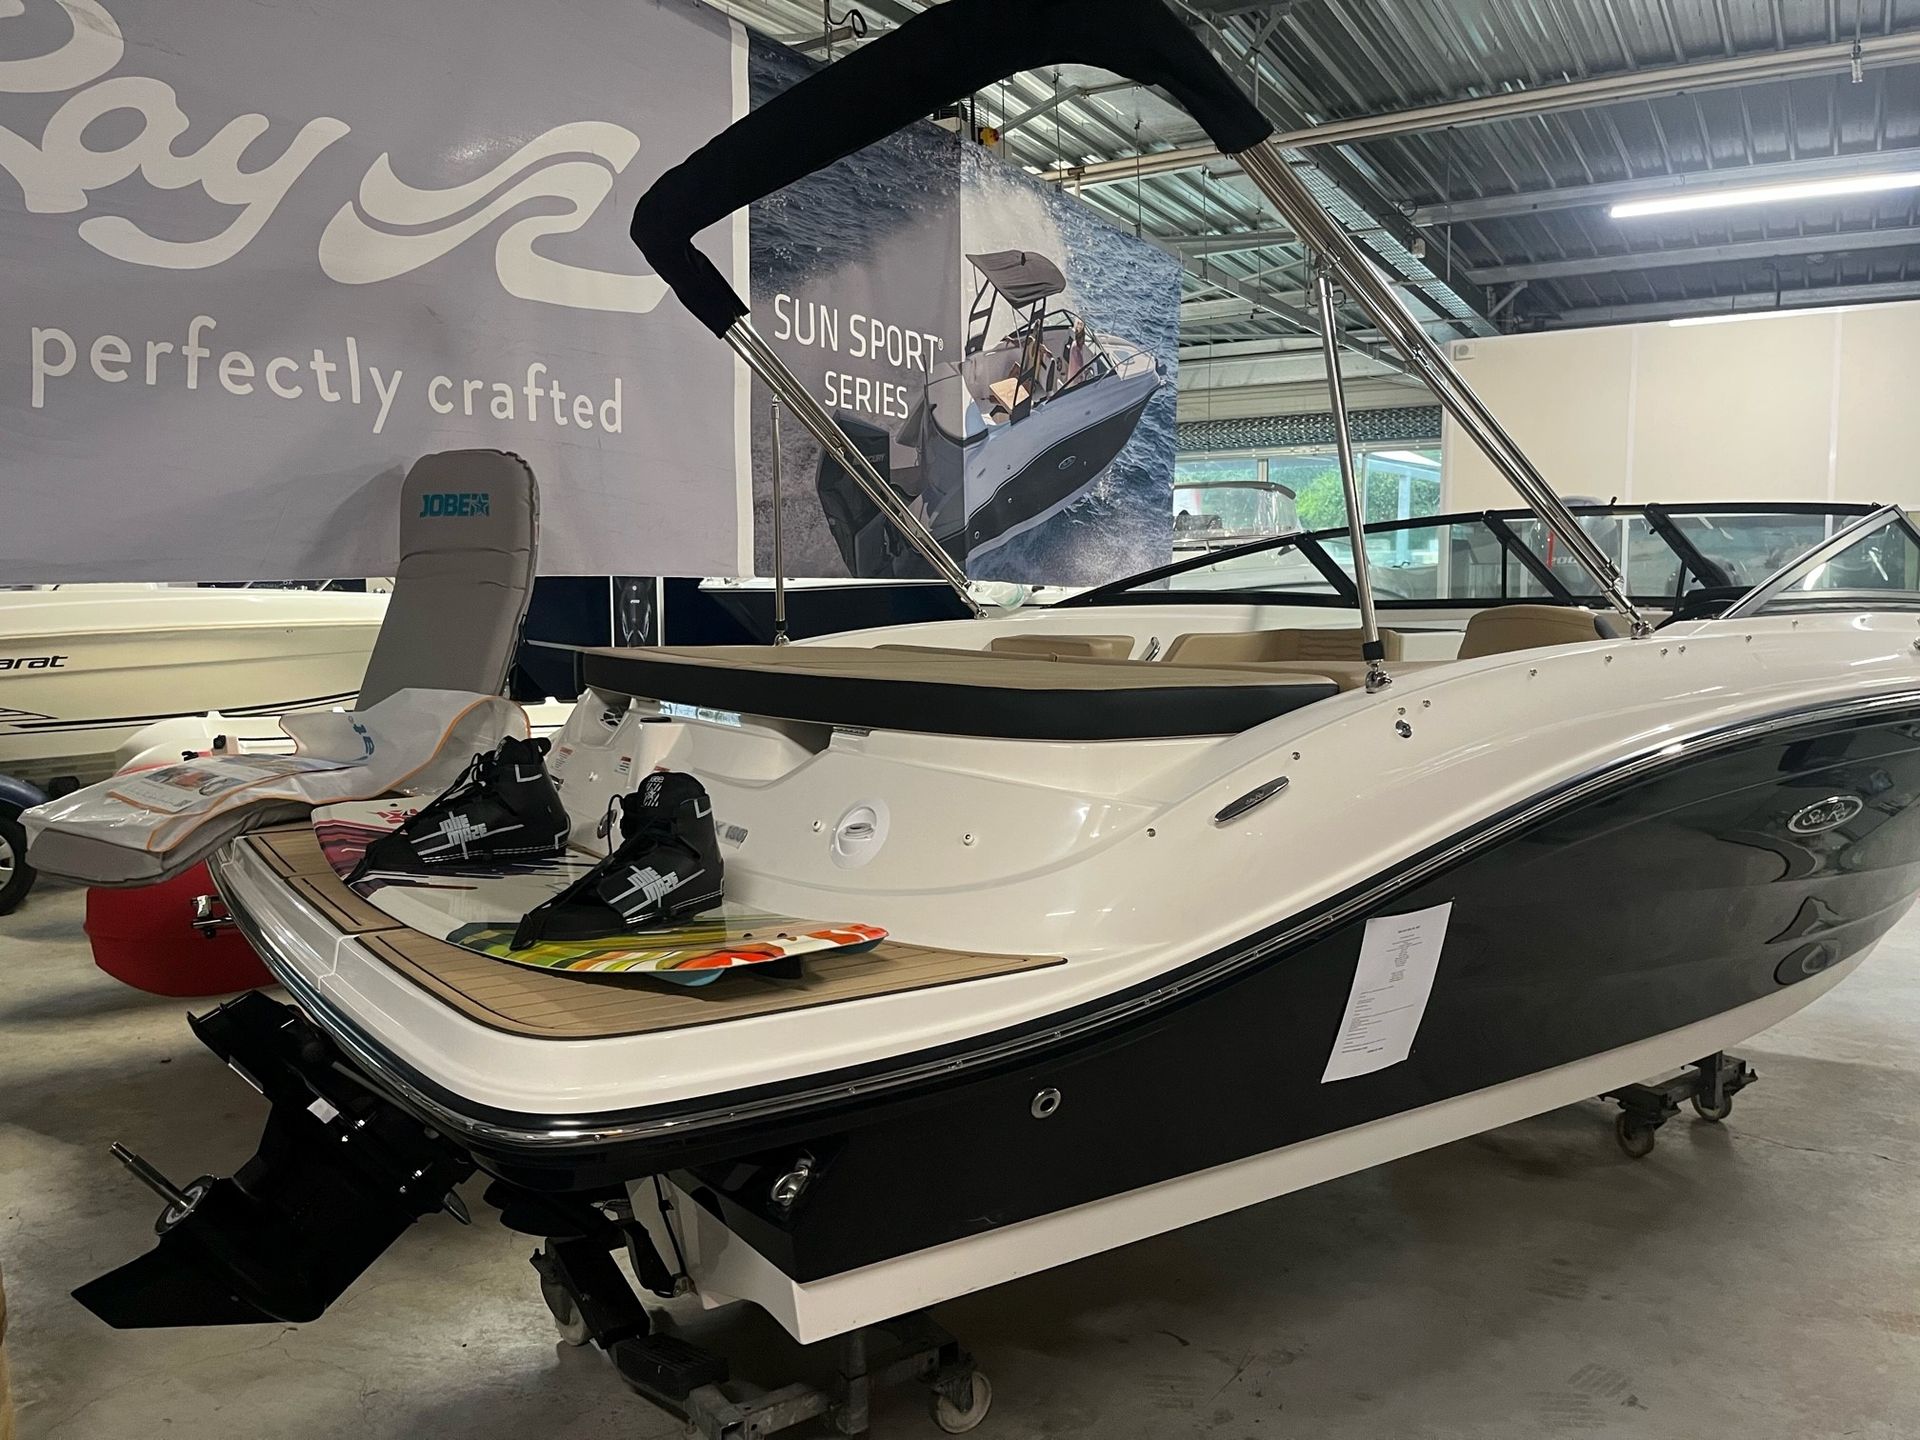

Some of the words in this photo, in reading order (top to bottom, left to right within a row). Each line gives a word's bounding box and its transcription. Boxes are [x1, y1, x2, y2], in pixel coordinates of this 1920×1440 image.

[774, 293, 838, 352] SUN
[31, 315, 403, 435] perfectly
[427, 363, 623, 434] crafted
[824, 370, 909, 419] SERIES
[420, 493, 471, 518] JOBE
